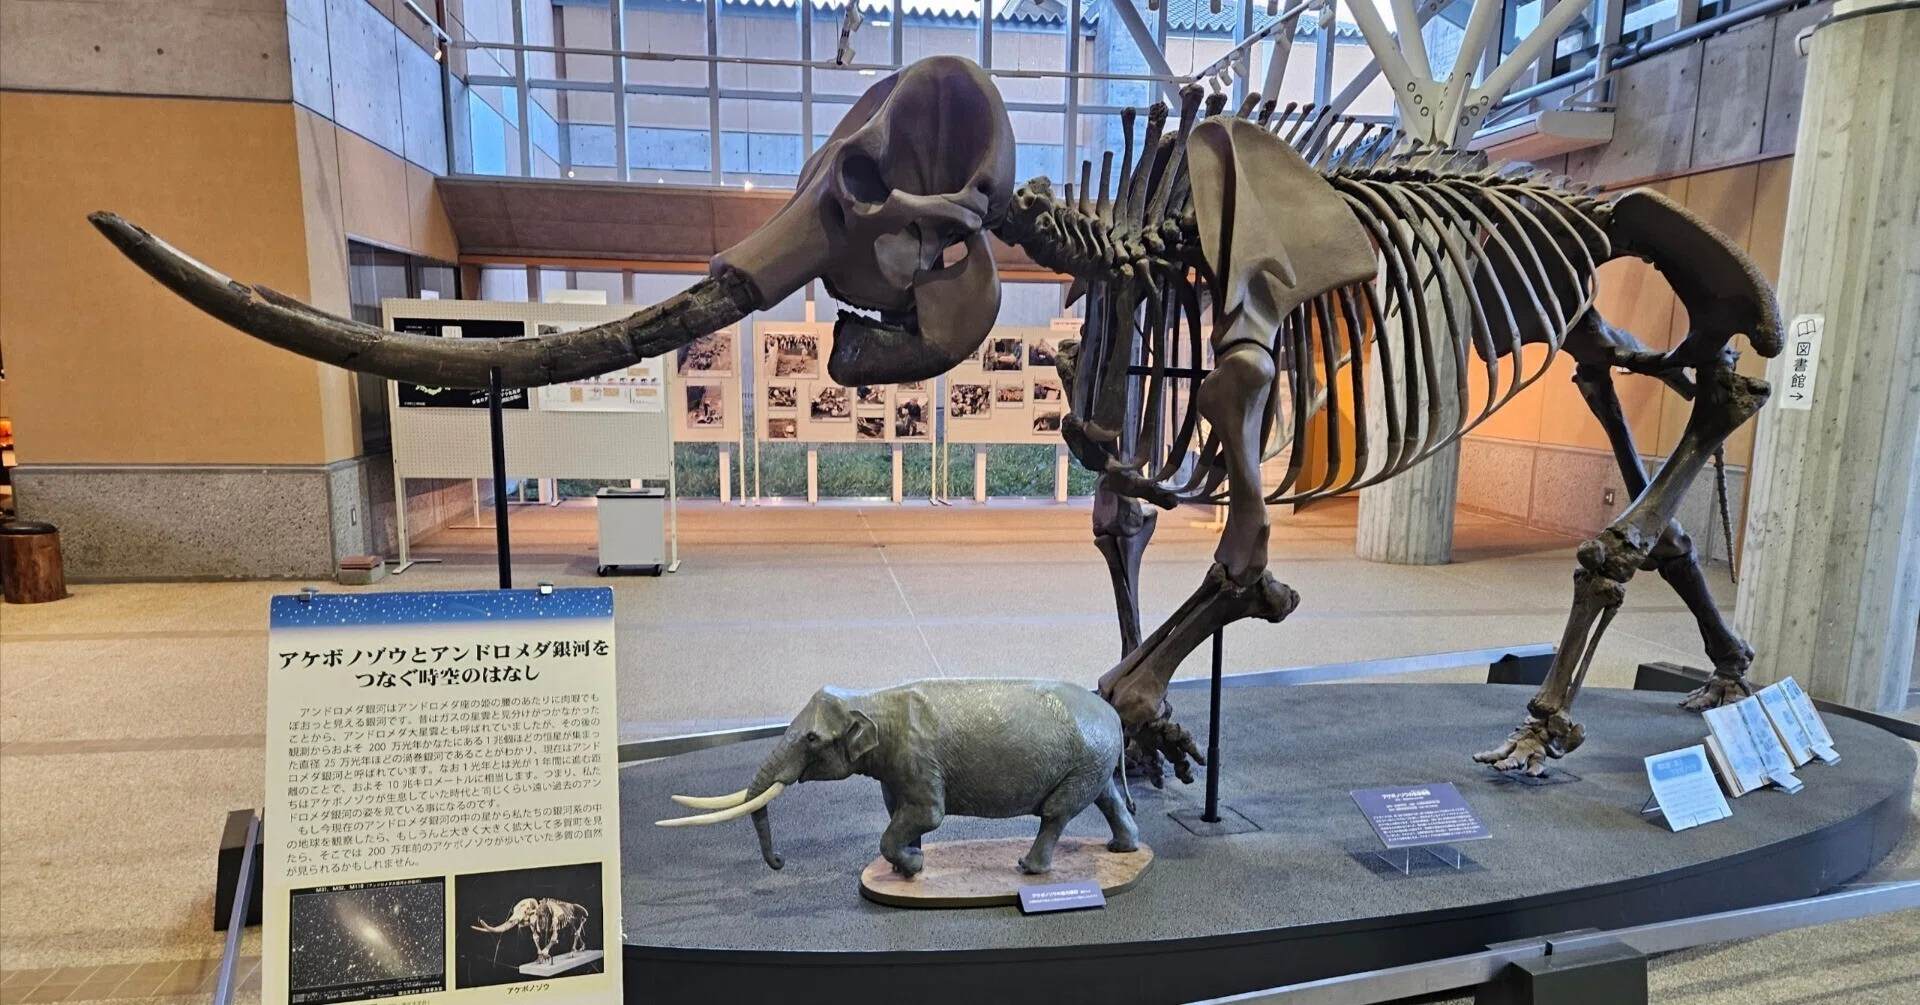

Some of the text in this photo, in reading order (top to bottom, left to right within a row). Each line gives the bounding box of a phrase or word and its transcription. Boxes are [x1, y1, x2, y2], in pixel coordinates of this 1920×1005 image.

[1791, 342, 1811, 388] 図書館
[279, 639, 609, 670] アケボノゾウとアンドロメダ銀河を
[355, 666, 540, 688] つなぐ時空のはなし
[286, 857, 419, 877] が見られるかもしれません。
[507, 983, 550, 995] アケボノゾウ
